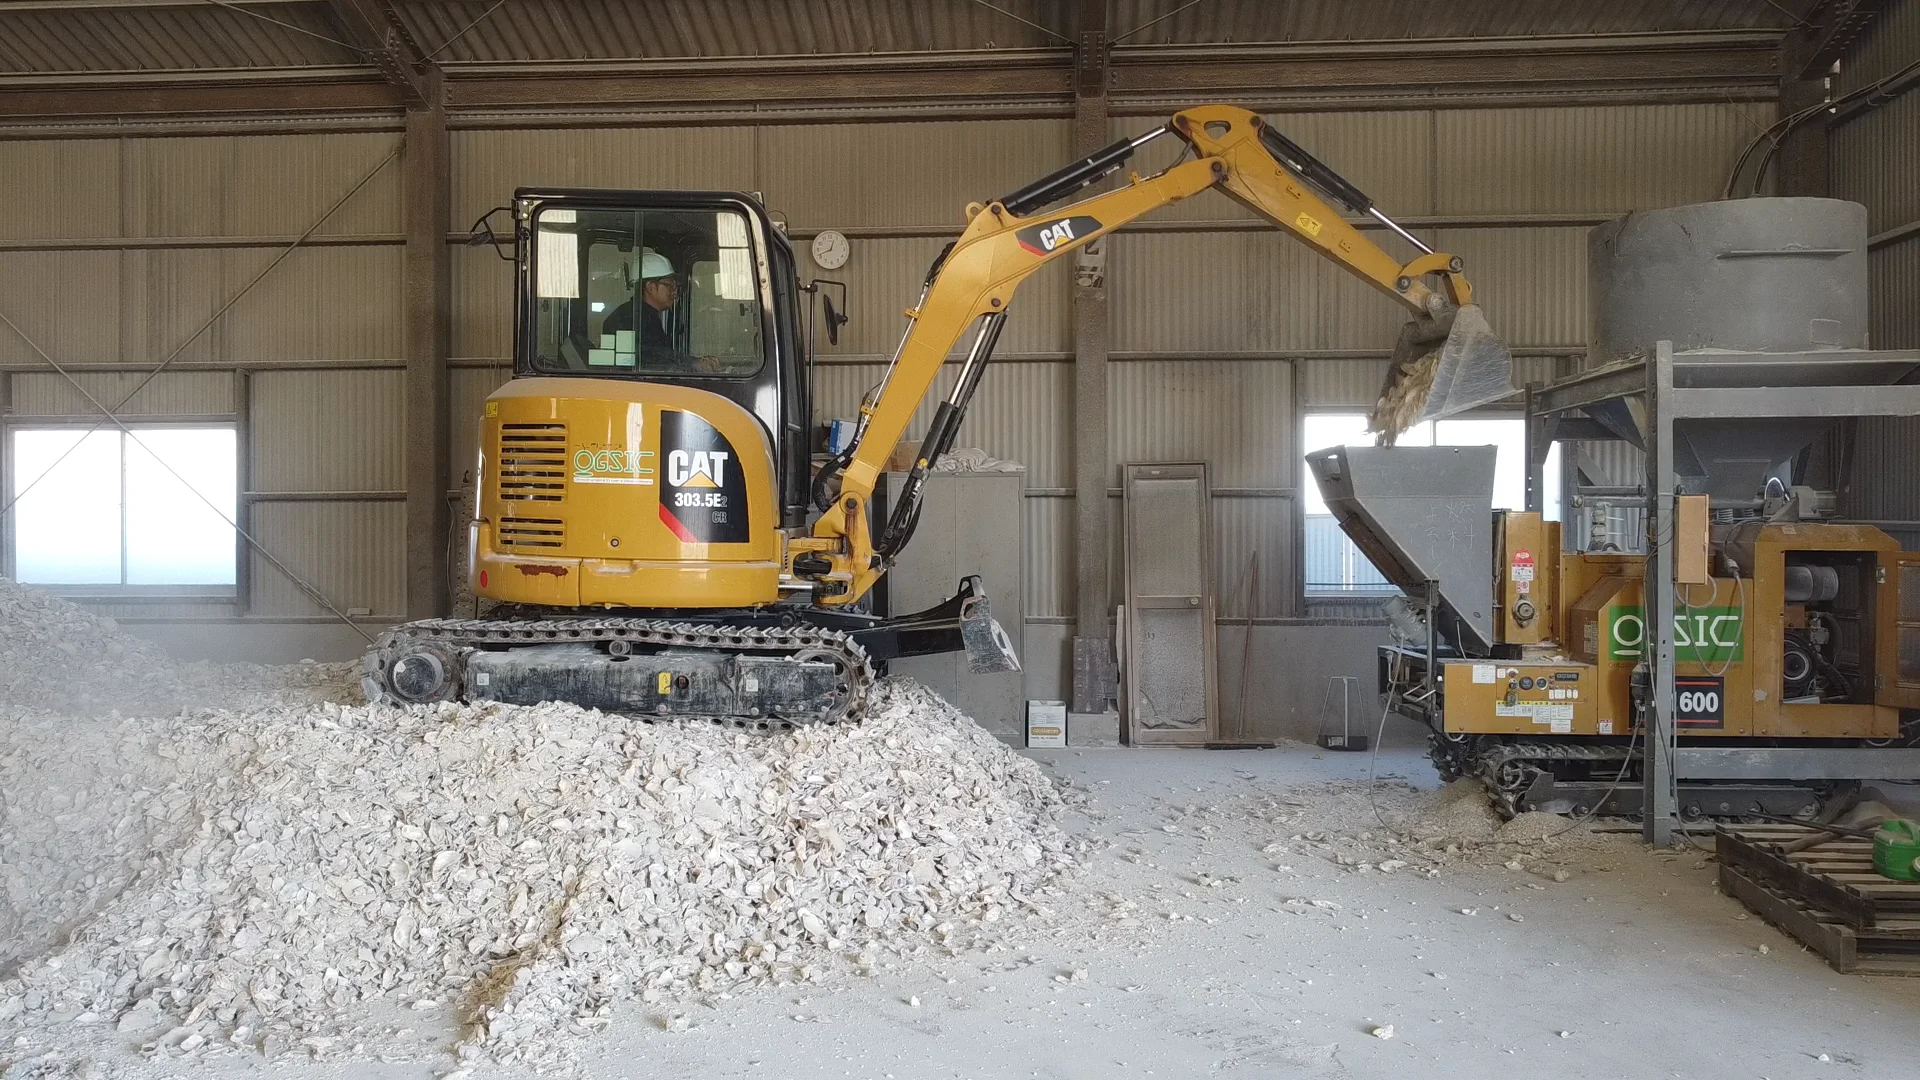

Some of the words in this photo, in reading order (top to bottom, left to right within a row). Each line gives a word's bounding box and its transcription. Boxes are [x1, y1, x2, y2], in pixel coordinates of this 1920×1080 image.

[1039, 218, 1075, 251] CAT
[574, 449, 655, 473] OGSIC
[668, 449, 729, 488] CAT
[674, 492, 728, 508] 303.5E2
[711, 510, 728, 524] CR
[1612, 614, 1739, 647] OSIC
[1679, 691, 1719, 713] 600
